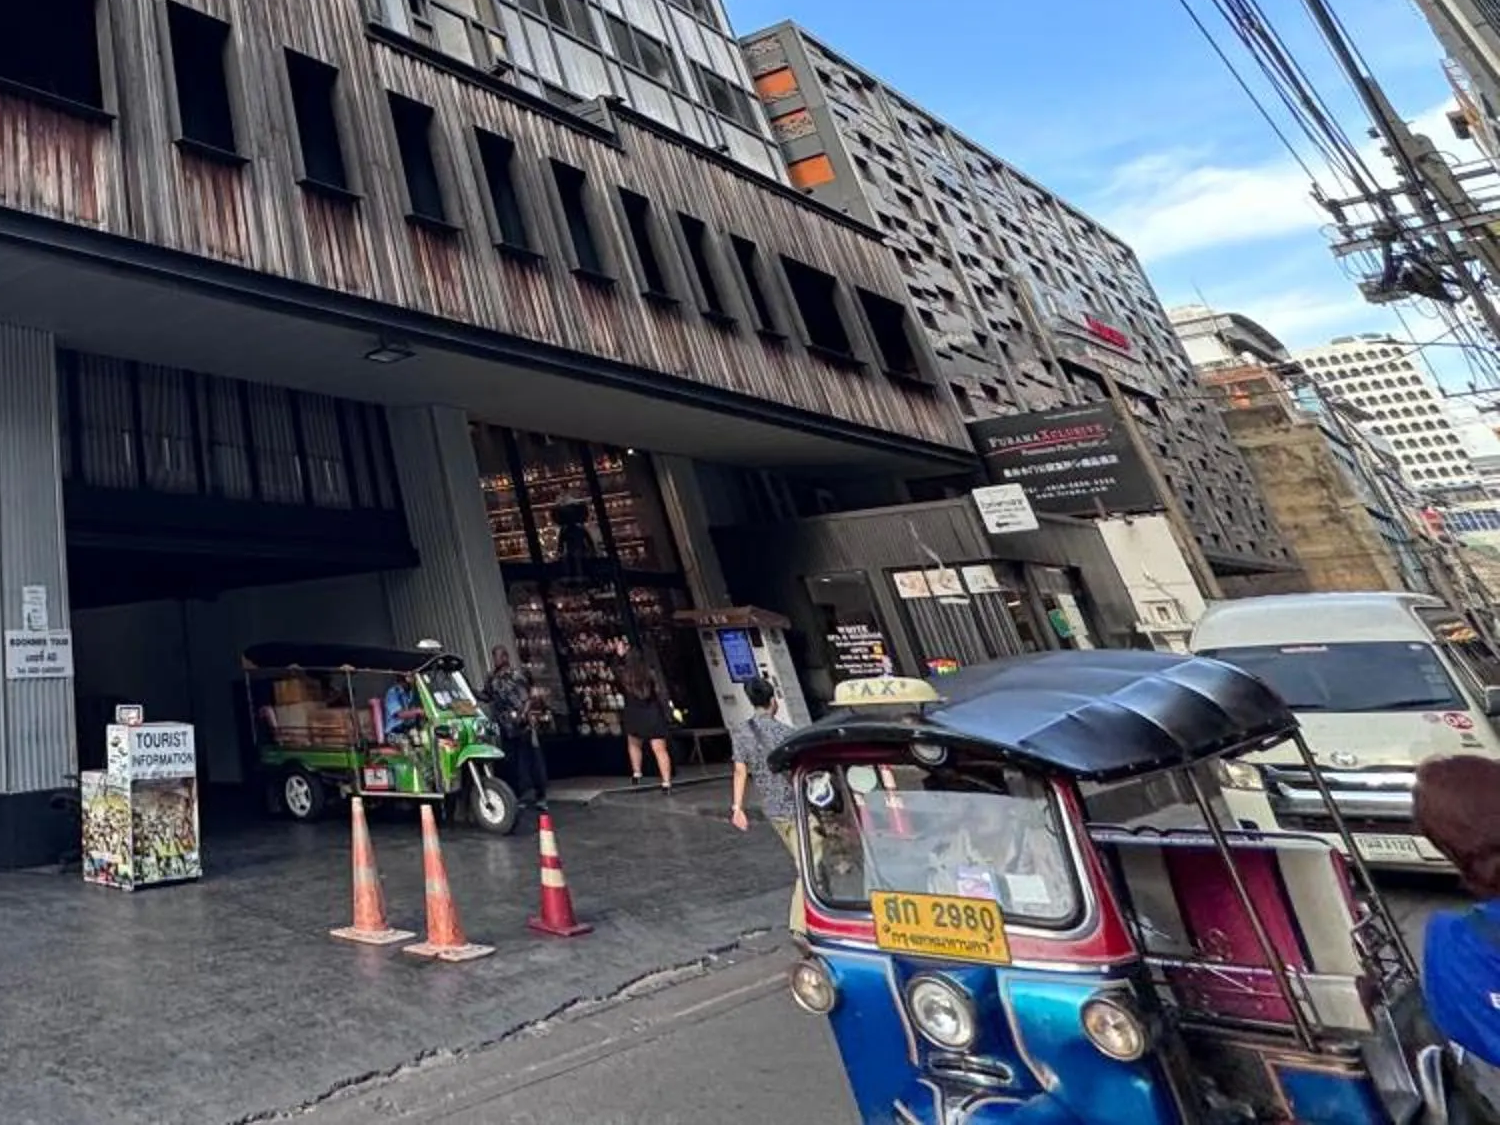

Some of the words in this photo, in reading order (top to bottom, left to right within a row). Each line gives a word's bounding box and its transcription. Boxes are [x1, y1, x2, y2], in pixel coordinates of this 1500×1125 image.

[136, 730, 188, 749] TOURIST
[132, 751, 195, 767] INFORMATION
[931, 901, 995, 934] 2980
